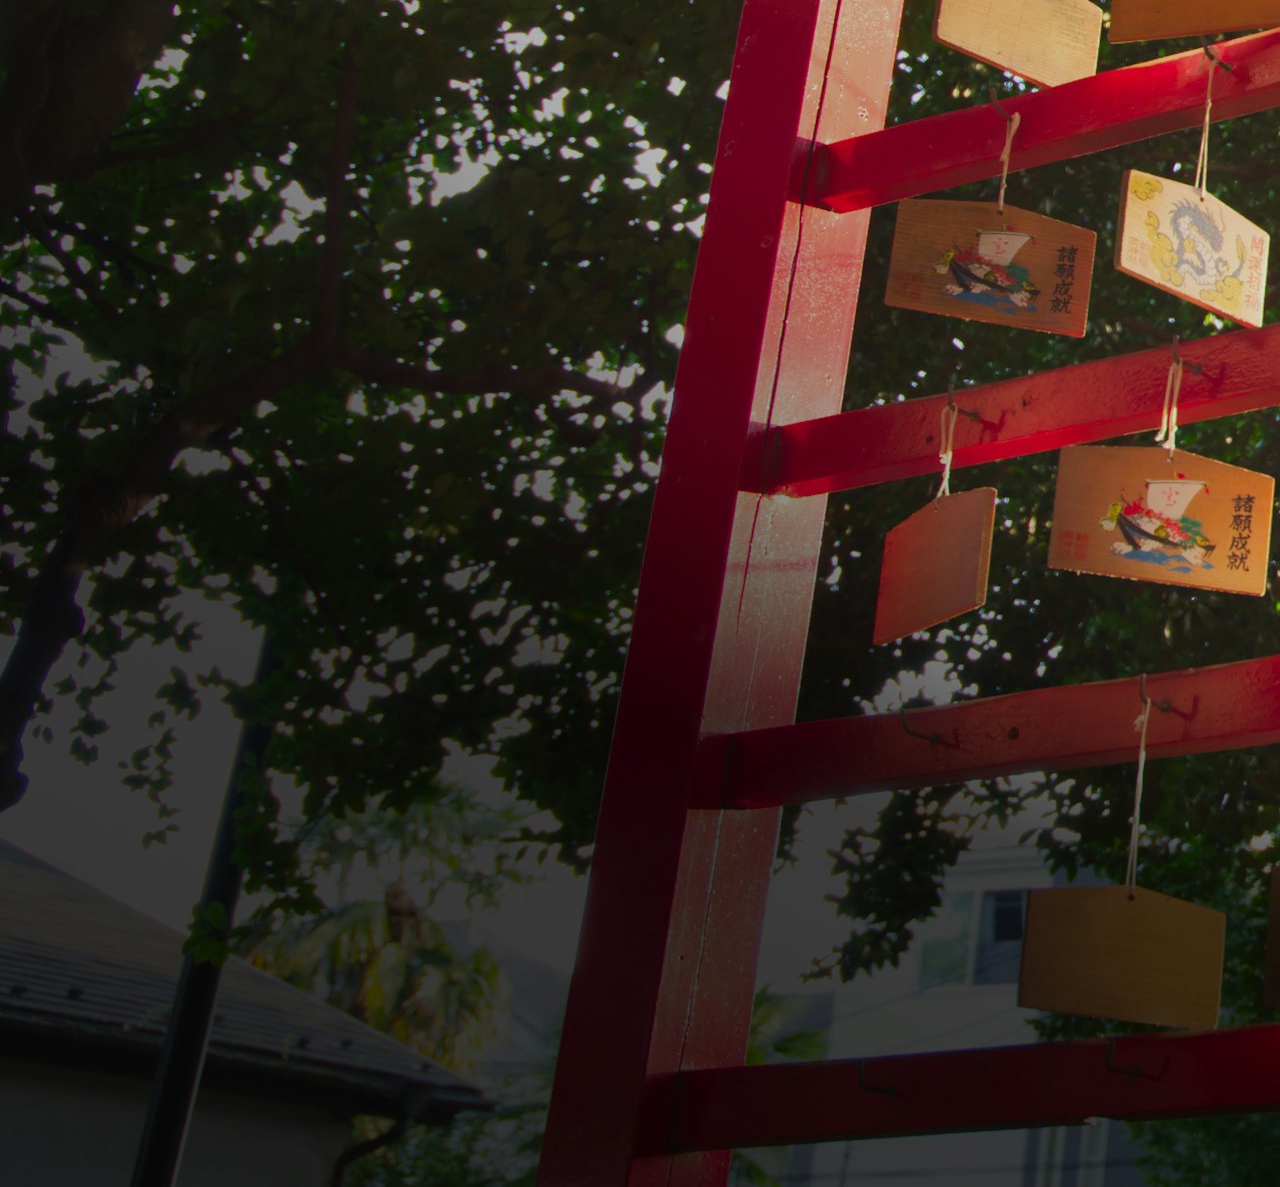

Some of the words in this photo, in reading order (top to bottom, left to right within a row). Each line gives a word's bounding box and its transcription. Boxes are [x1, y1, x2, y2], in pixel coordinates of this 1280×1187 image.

[1049, 245, 1078, 315] 諸願成就
[1228, 494, 1253, 572] 諸願成就
